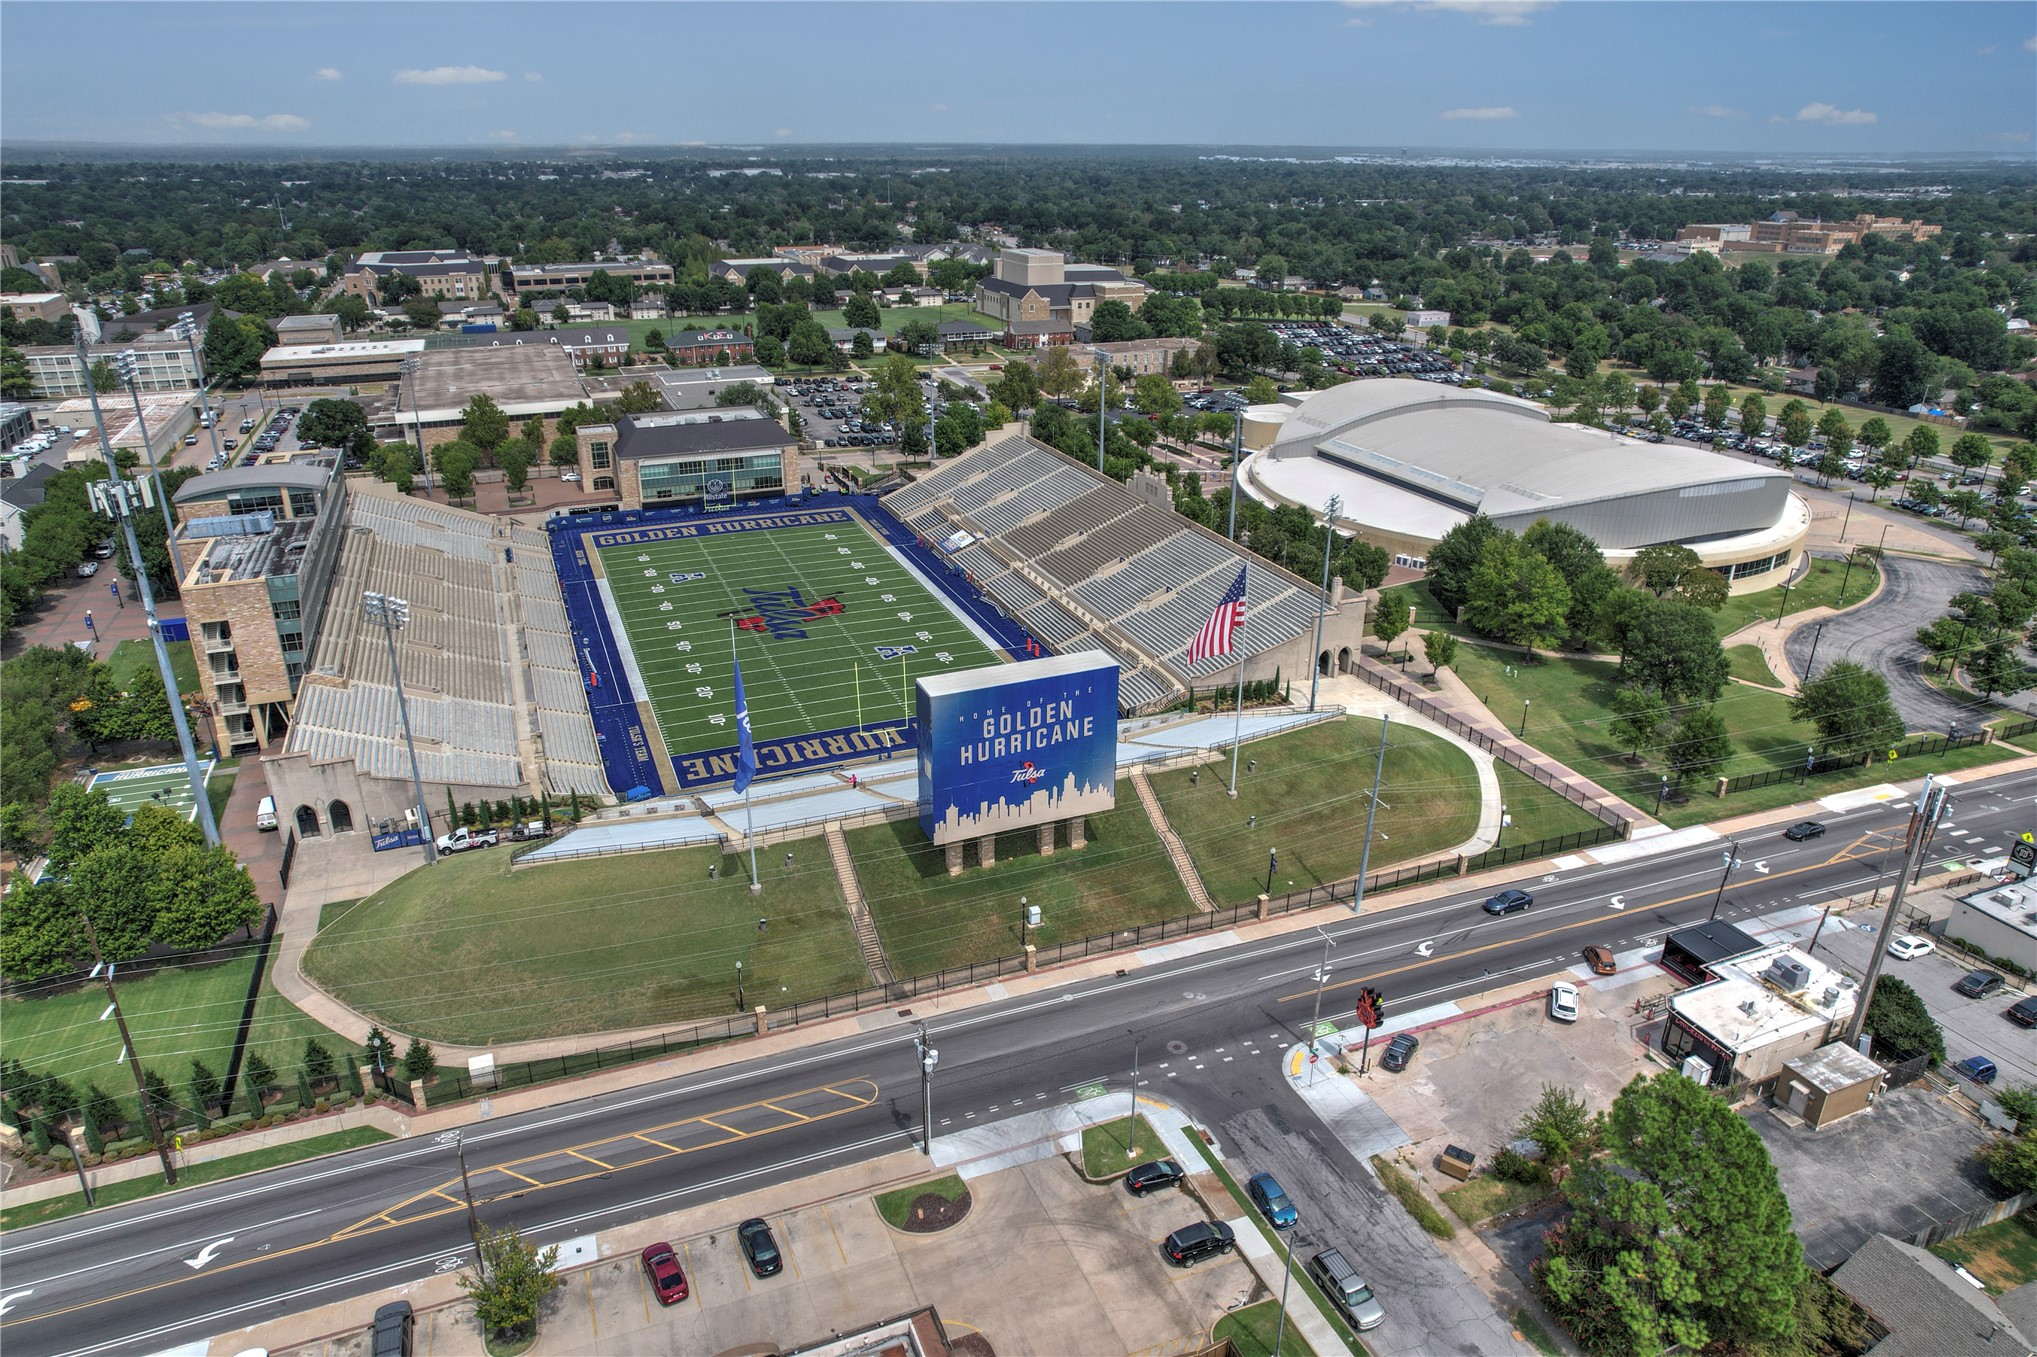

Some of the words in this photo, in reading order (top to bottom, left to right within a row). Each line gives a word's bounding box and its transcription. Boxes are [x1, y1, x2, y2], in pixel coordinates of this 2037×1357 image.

[703, 492, 728, 501] Allstate
[599, 526, 699, 546] GOLDEN
[707, 512, 848, 533] HURRICANE
[742, 586, 816, 640] Tulsa
[935, 652, 954, 662] 20
[685, 662, 702, 673] 30
[696, 686, 714, 698] 20
[959, 706, 1007, 722] HOME
[1026, 697, 1044, 708] OF
[1063, 686, 1093, 698] THE
[708, 713, 726, 724] 10
[983, 700, 1073, 739] GOLDEN
[960, 716, 1094, 766] HURRICANE
[113, 767, 188, 781] HURRICAN
[1009, 767, 1046, 784] Tulsa
[374, 835, 399, 849] Tulsa
